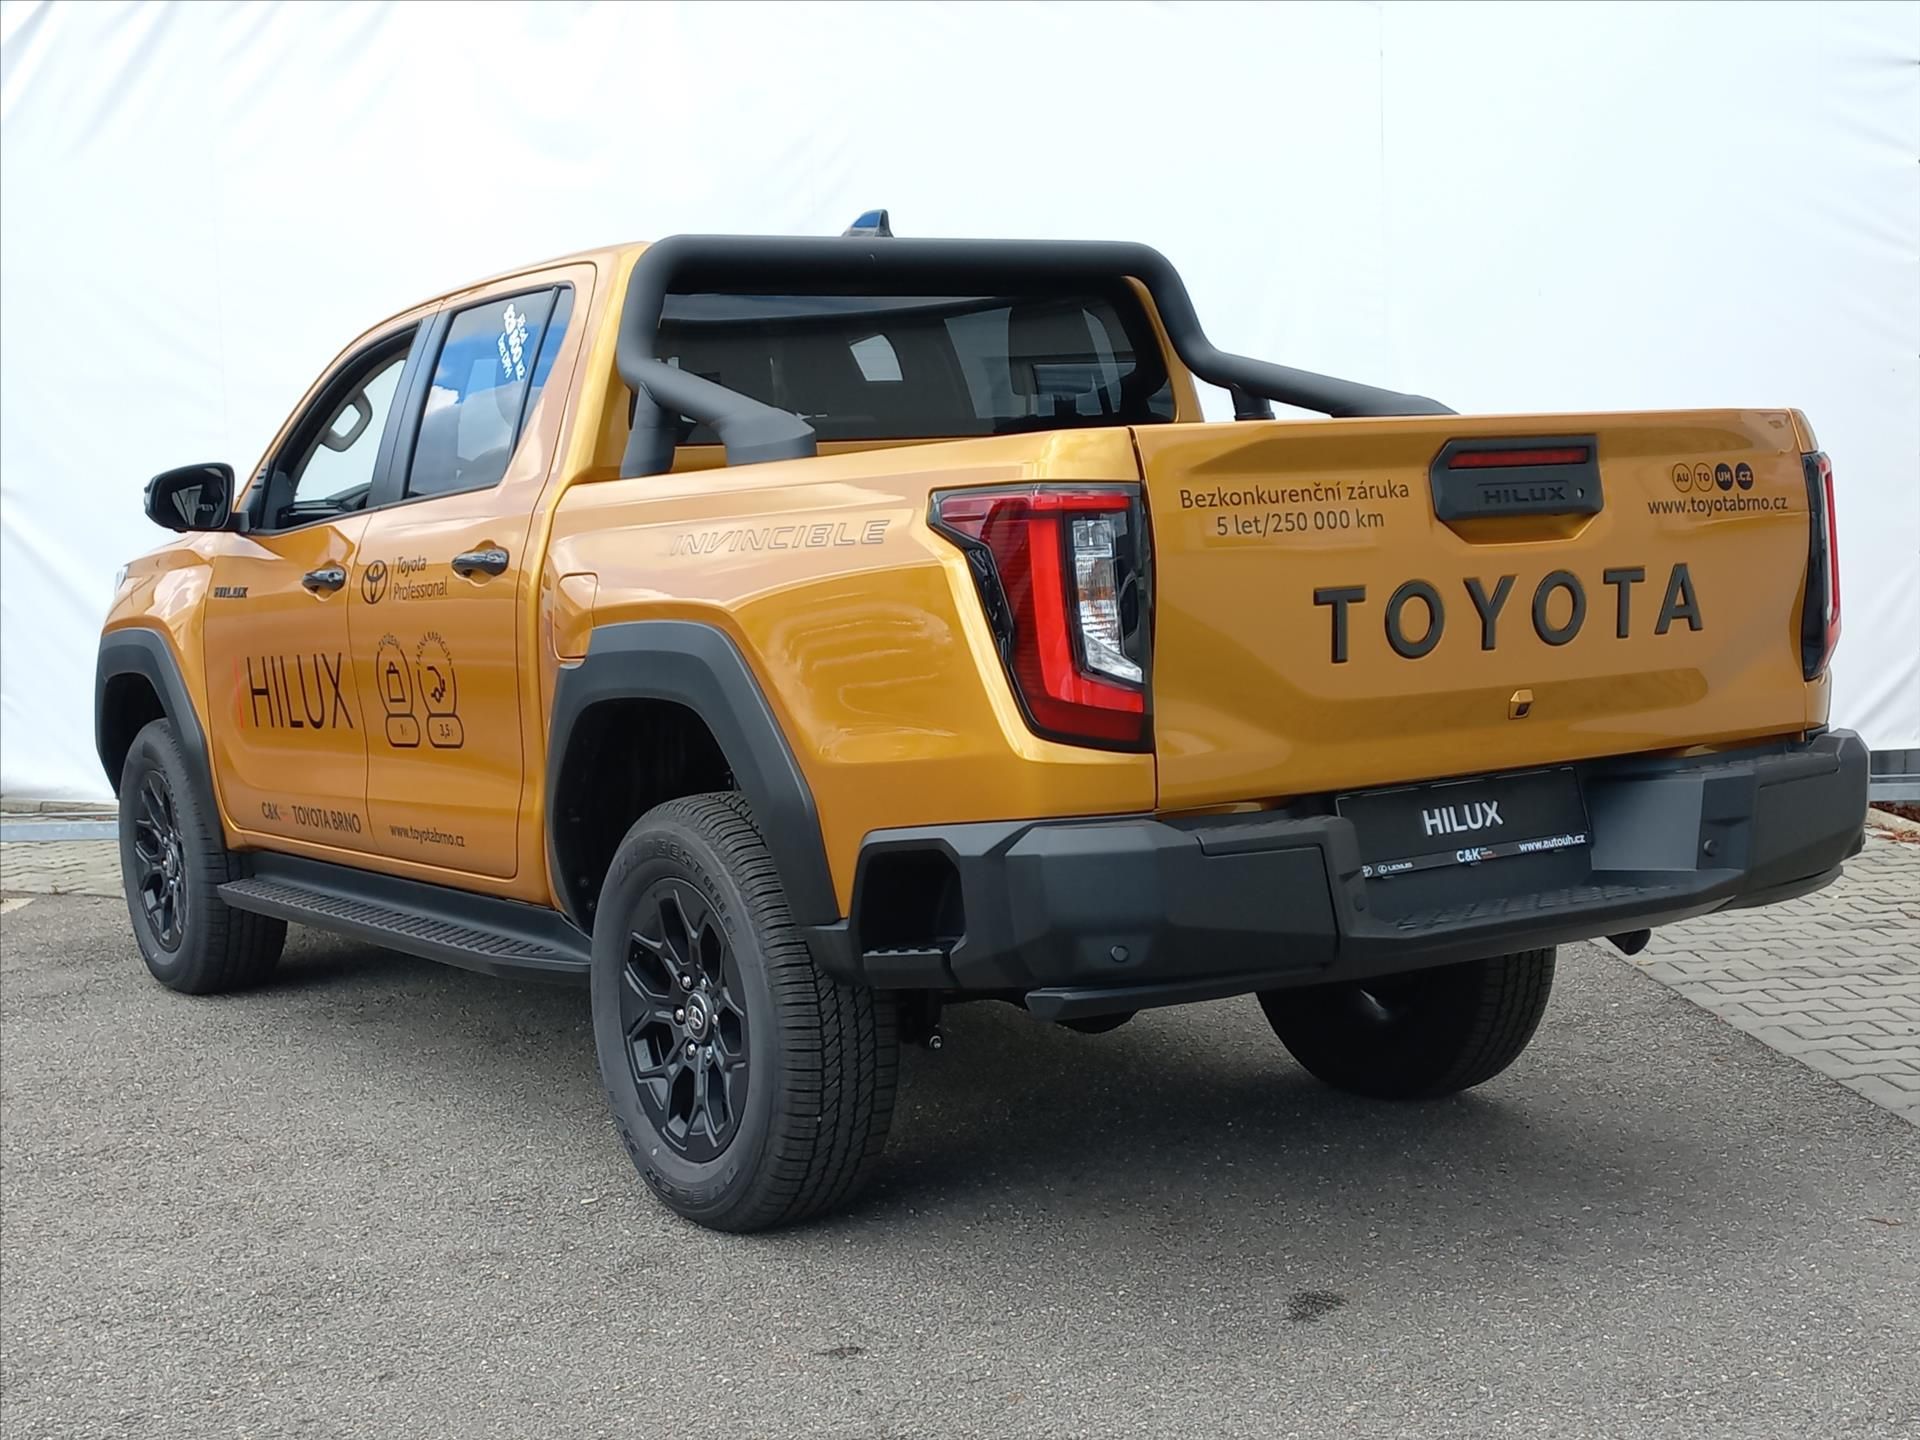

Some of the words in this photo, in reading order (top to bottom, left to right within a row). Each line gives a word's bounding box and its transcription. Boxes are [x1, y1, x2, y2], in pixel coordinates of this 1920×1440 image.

[1179, 482, 1343, 509] Bezkonkurenční
[1346, 479, 1410, 501] záruka
[1483, 487, 1566, 504] HILUX
[1647, 493, 1789, 517] www.toyotabrno.cz
[669, 519, 891, 557] INVINCIBLE
[1216, 516, 1229, 536] 5
[1234, 511, 1308, 538] let/250
[1313, 509, 1351, 531] 000
[1355, 508, 1385, 529] km
[396, 555, 428, 578] Toyota
[392, 576, 448, 601] Professional
[1312, 562, 1704, 665] TOYOTA
[246, 652, 354, 730] HILUX
[291, 804, 333, 830] TOYOTA
[331, 808, 362, 835] BRNO
[1422, 800, 1504, 837] HILUX
[389, 824, 466, 848] www.toyotabrno.cz
[1456, 847, 1481, 863] C&K
[1518, 834, 1587, 853] www.autouh.cz
